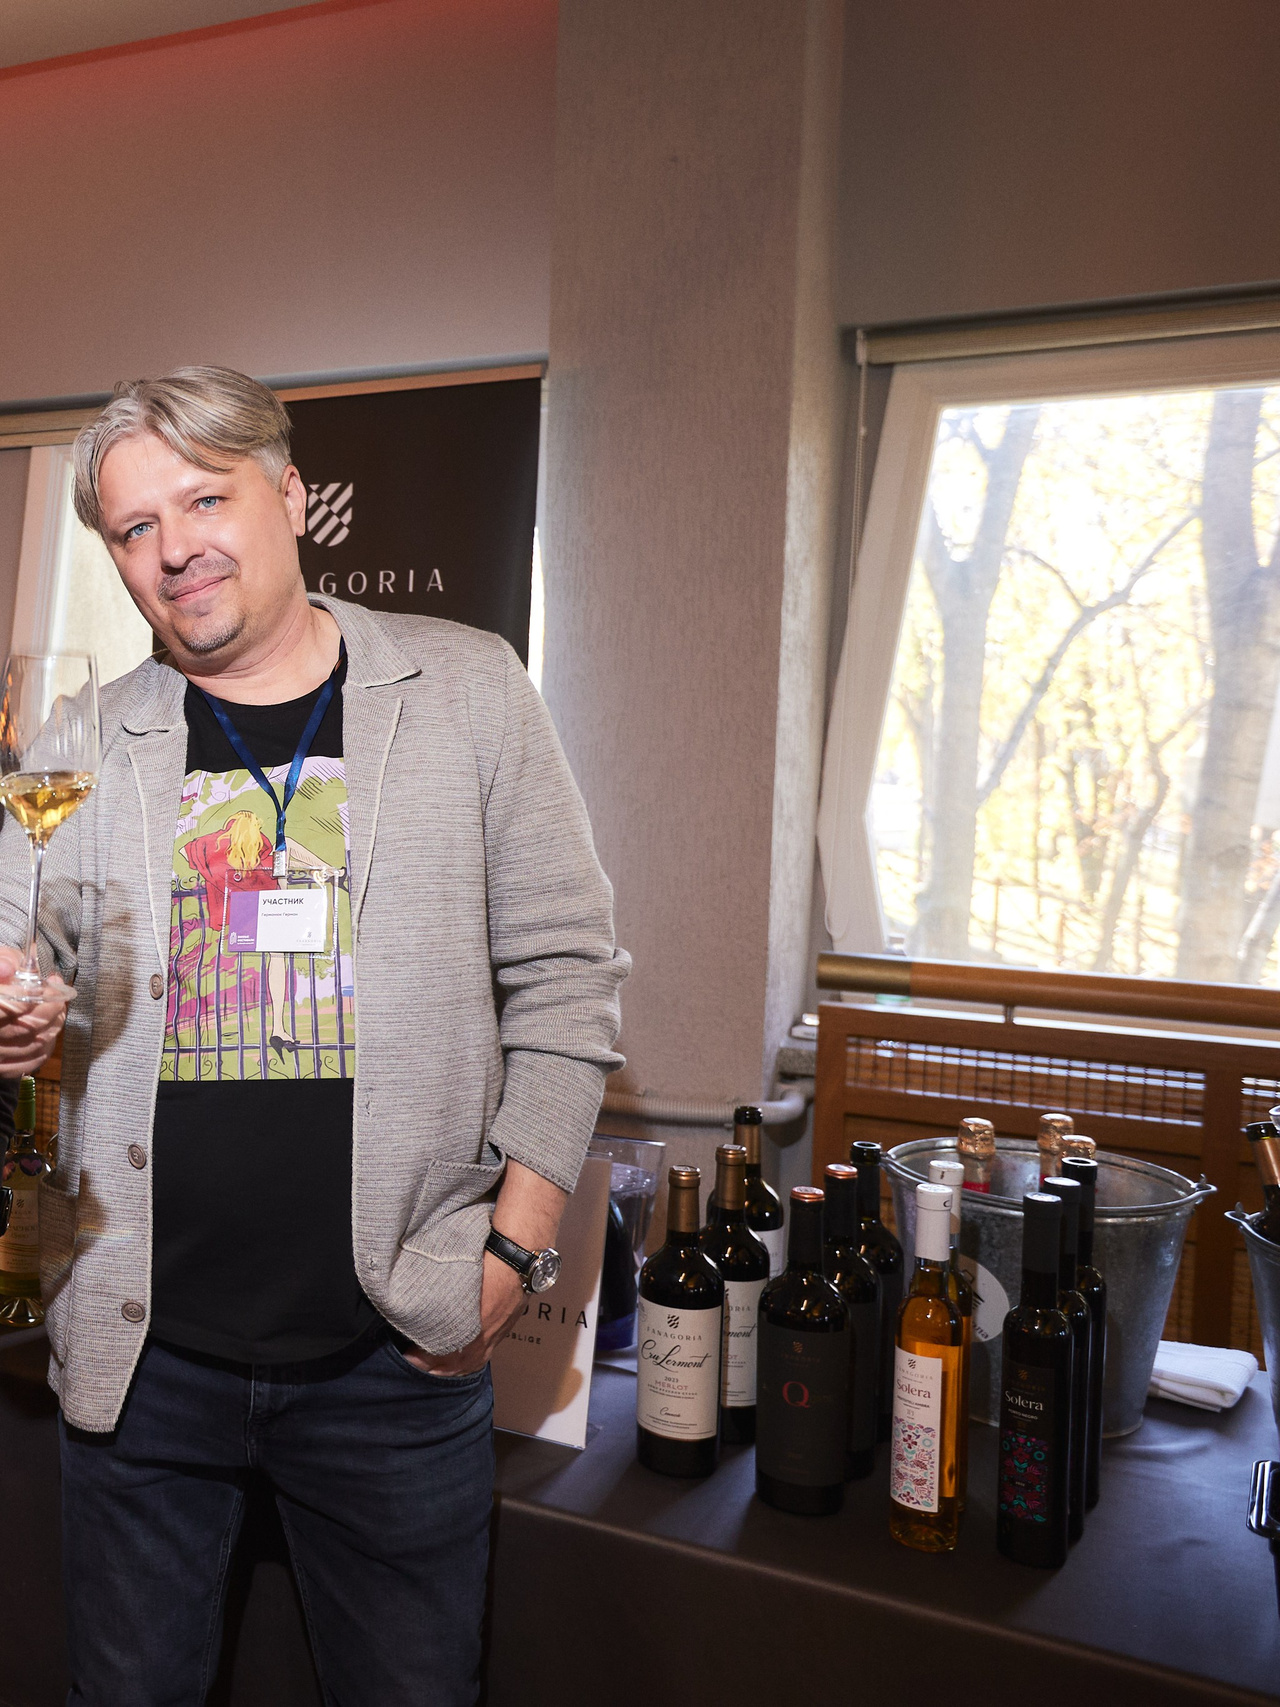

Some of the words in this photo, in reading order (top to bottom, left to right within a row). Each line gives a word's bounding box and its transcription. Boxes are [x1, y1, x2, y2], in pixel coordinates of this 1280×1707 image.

[318, 568, 444, 596] GORIA
[646, 1326, 702, 1341] FANAGORIA
[641, 1339, 660, 1360] Cru
[652, 1345, 712, 1373] Lermont
[655, 1380, 688, 1390] MERLOT
[782, 1381, 811, 1409] Q
[896, 1379, 931, 1399] Solera
[1005, 1390, 1043, 1411] Solera
